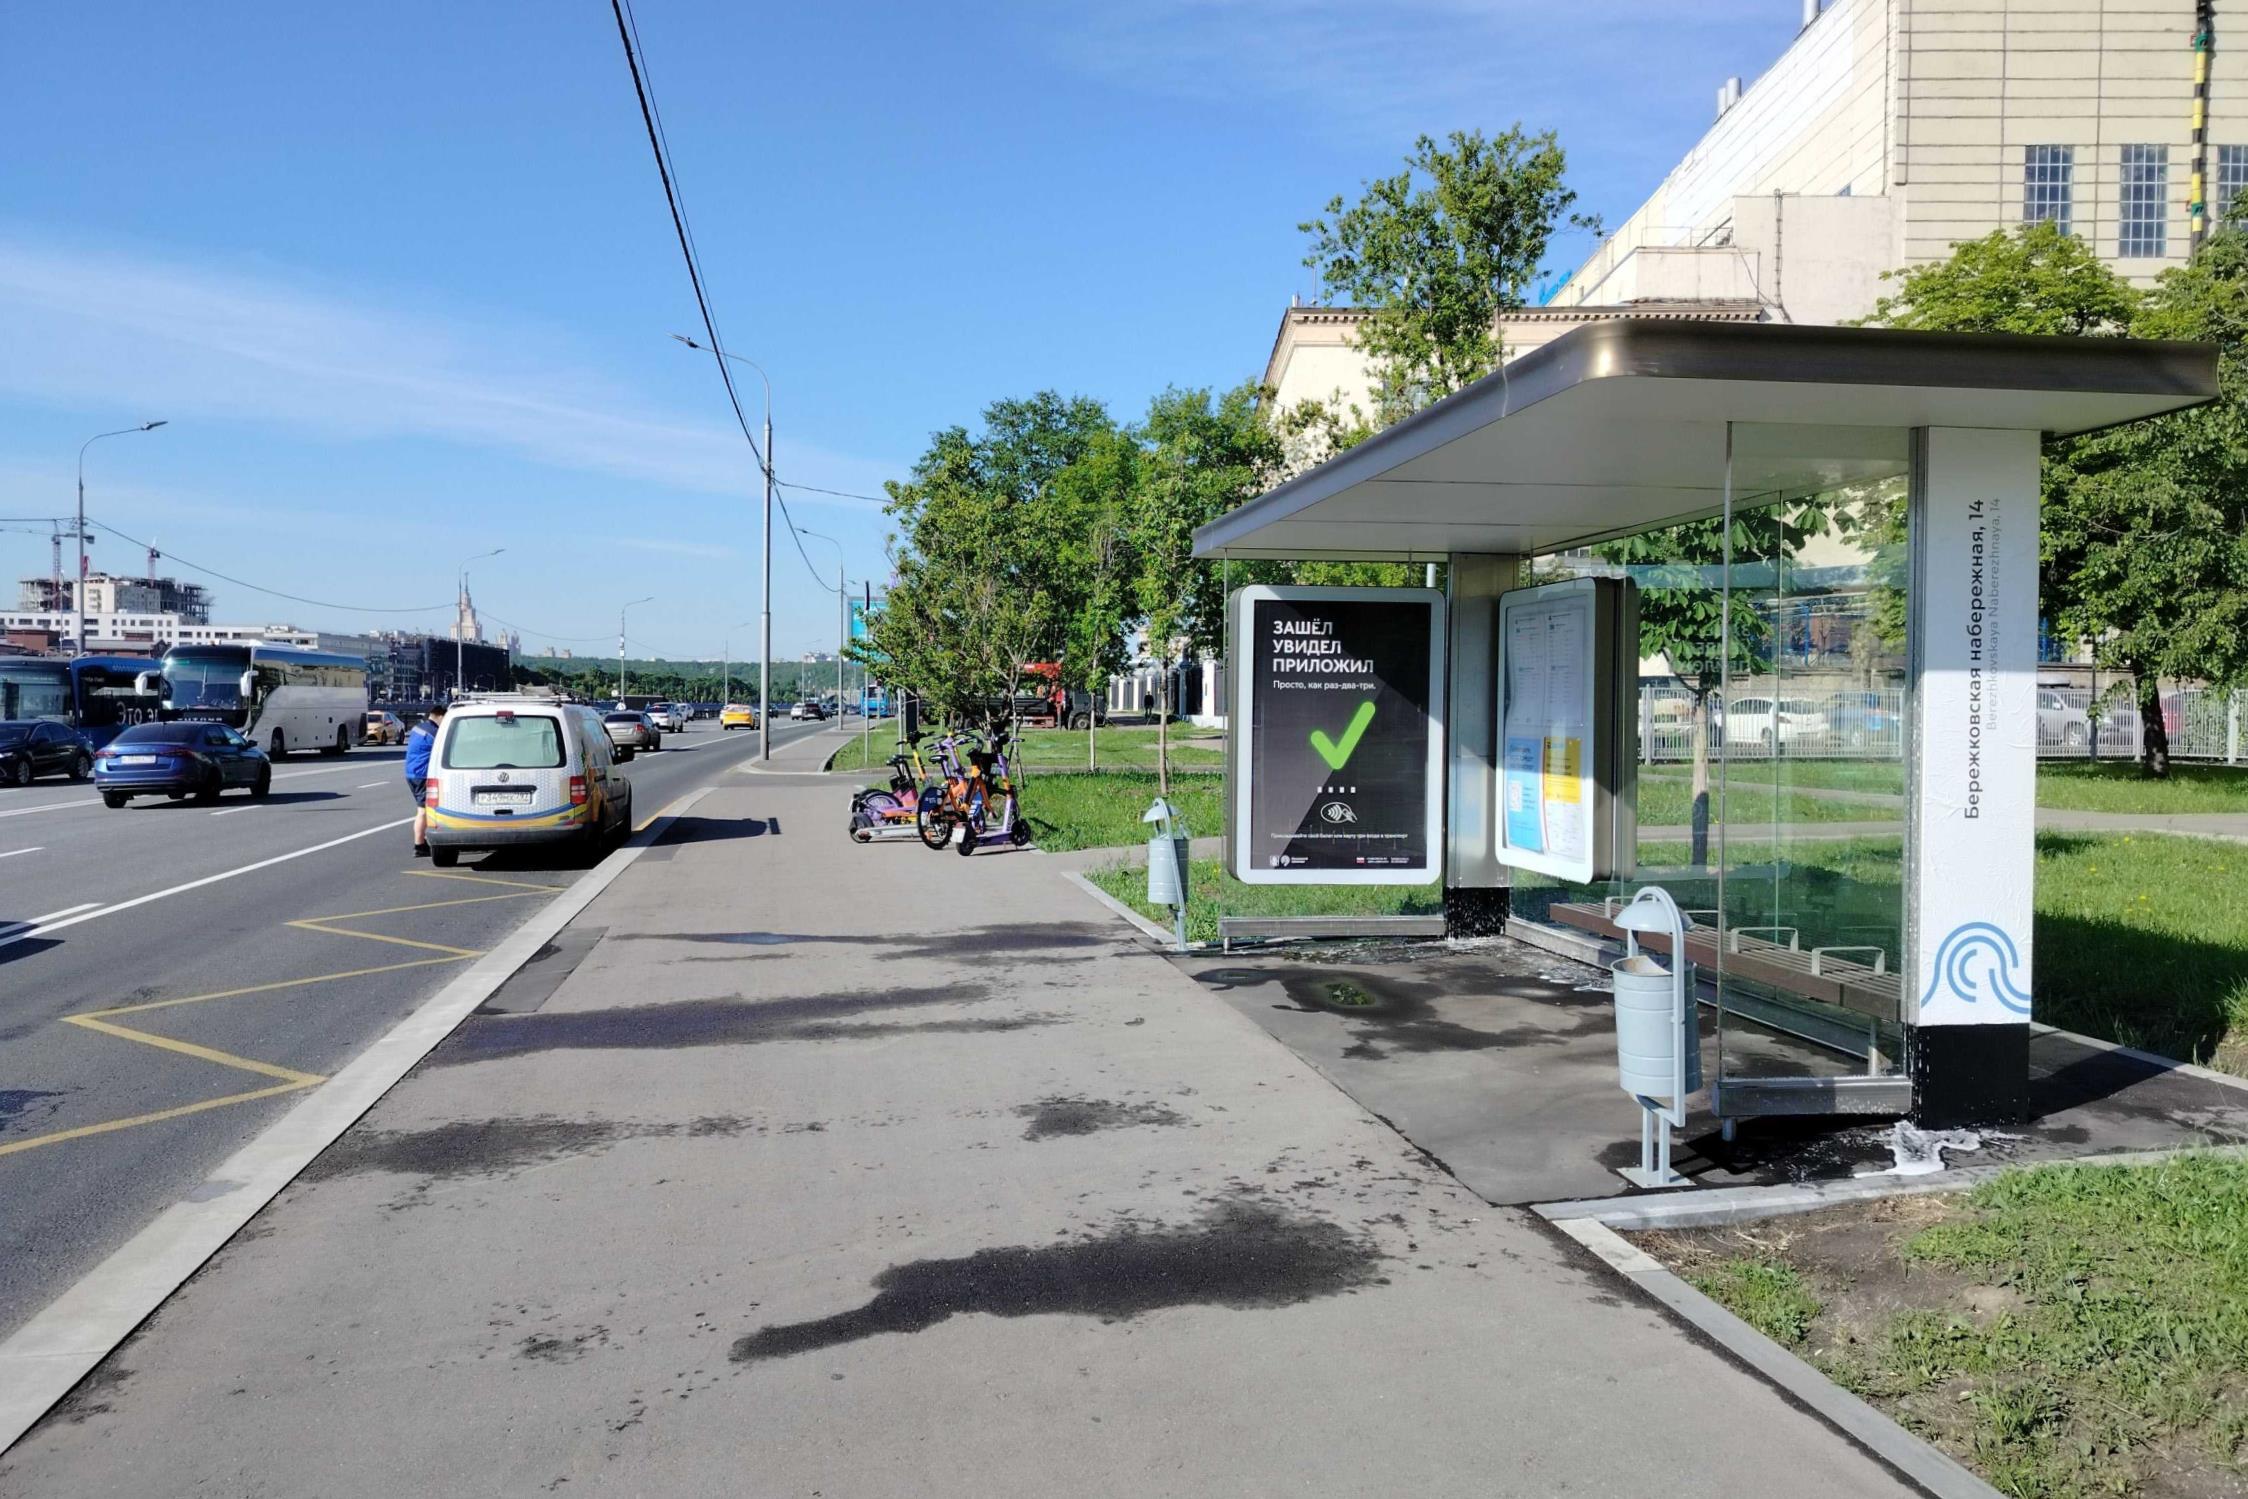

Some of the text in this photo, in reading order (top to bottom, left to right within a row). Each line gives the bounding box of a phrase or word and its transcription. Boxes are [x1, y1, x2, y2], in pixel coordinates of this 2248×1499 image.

[1986, 498, 2002, 730] Berezhkovskaya Naberezhnaya, 14
[1273, 617, 1333, 635] ЗАШЁЛ
[1273, 640, 1341, 655] УВИДЕЛ
[1273, 658, 1374, 673] ПРИЛОЖИЛ
[1964, 499, 1985, 819] Бережковская набережная, 14
[1273, 680, 1376, 691] Просто, как раз-два-три.
